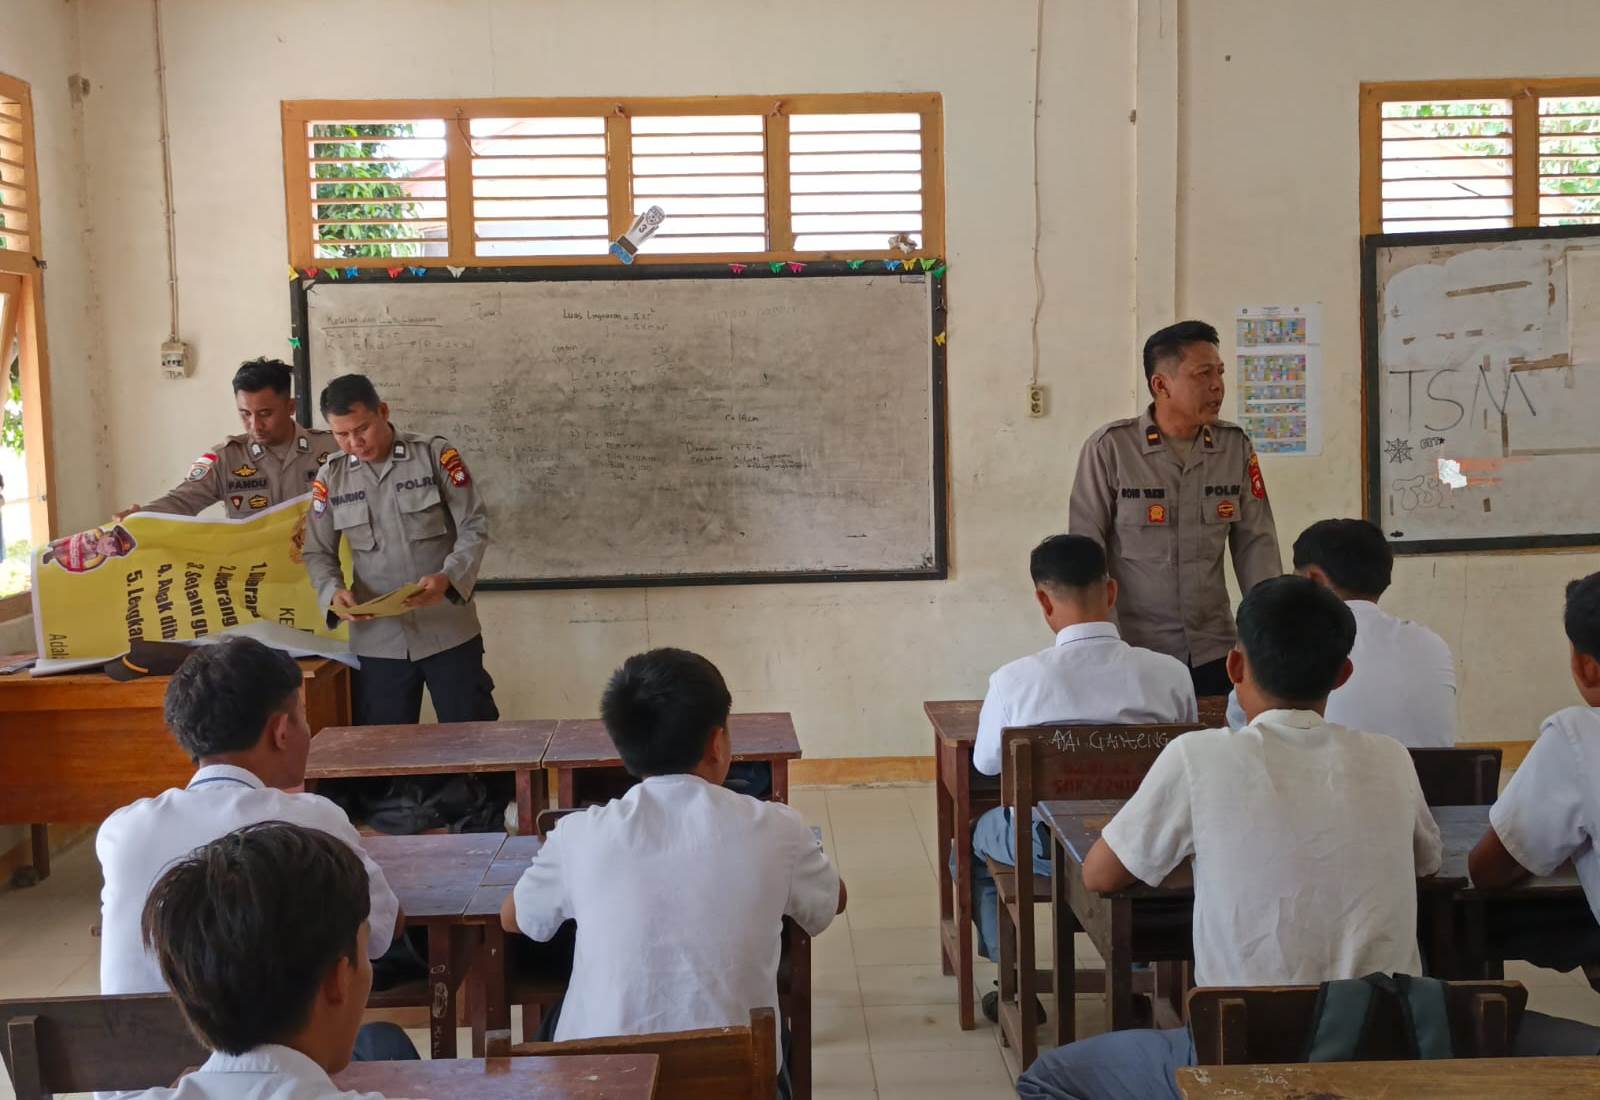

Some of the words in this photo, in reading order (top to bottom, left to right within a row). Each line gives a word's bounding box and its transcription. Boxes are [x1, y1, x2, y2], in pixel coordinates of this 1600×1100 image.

[125, 569, 143, 587] 5.
[157, 564, 173, 578] 4.
[155, 578, 176, 614] Anak
[184, 571, 205, 617] Selalu
